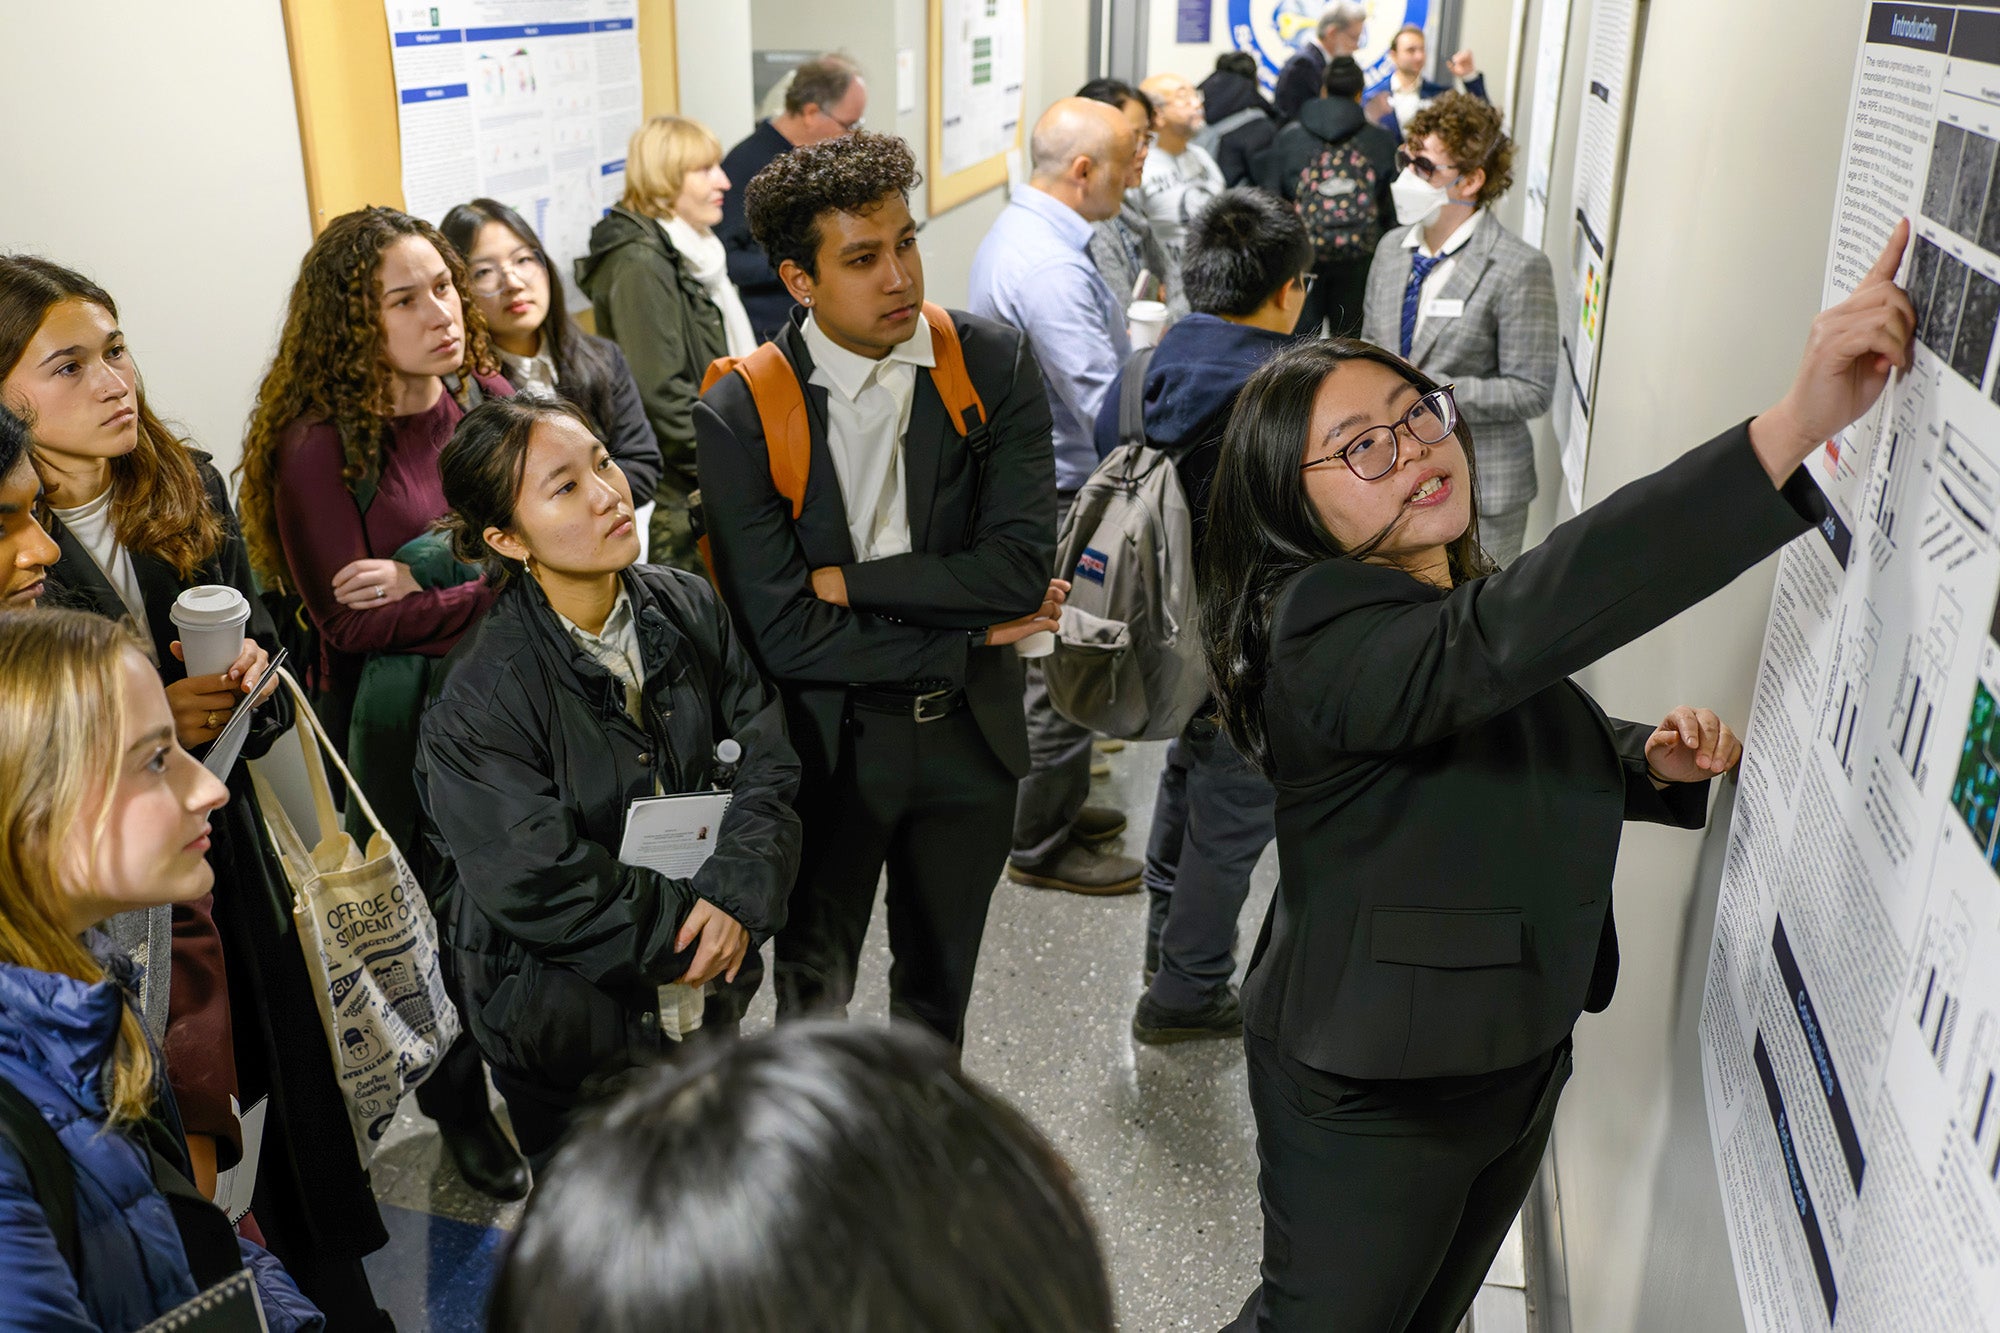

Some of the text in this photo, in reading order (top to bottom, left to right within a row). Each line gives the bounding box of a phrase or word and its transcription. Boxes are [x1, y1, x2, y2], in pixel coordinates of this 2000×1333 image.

[1890, 14, 1937, 42] Introduction
[327, 893, 389, 929] OFFICE
[336, 911, 394, 949] STUDENT
[333, 976, 354, 997] GU
[363, 1061, 377, 1075] ALL
